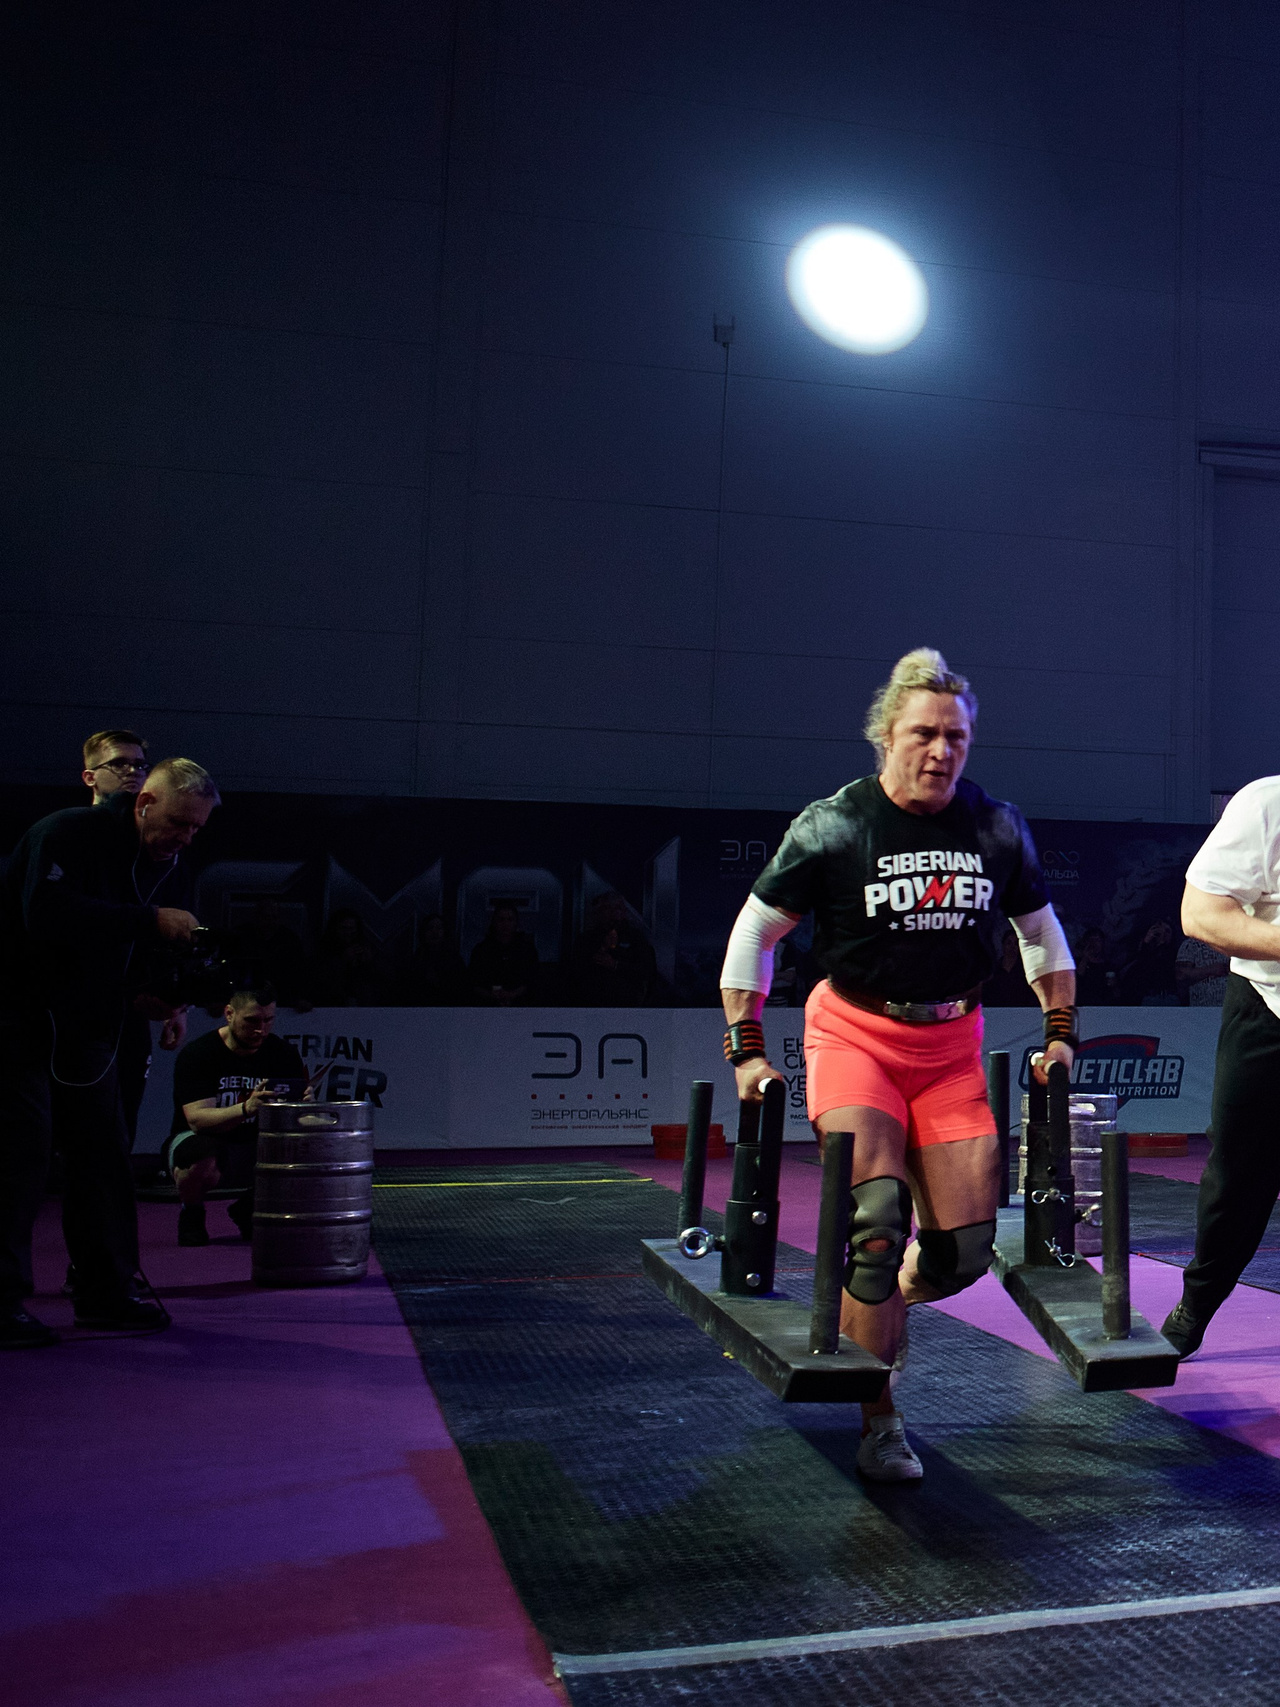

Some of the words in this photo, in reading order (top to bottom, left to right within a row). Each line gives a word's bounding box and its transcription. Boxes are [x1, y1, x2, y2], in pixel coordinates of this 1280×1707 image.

[877, 850, 984, 878] SIBERIAN
[1043, 868, 1080, 879] АЛЬФА
[864, 874, 994, 918] POWER
[903, 912, 966, 932] SHOW
[531, 1032, 647, 1079] ЭА
[218, 1076, 266, 1090] SIBERIA
[1108, 1084, 1178, 1096] NUTRITION
[531, 1108, 649, 1120] ЭНЕРГОАЛЬЯНС
